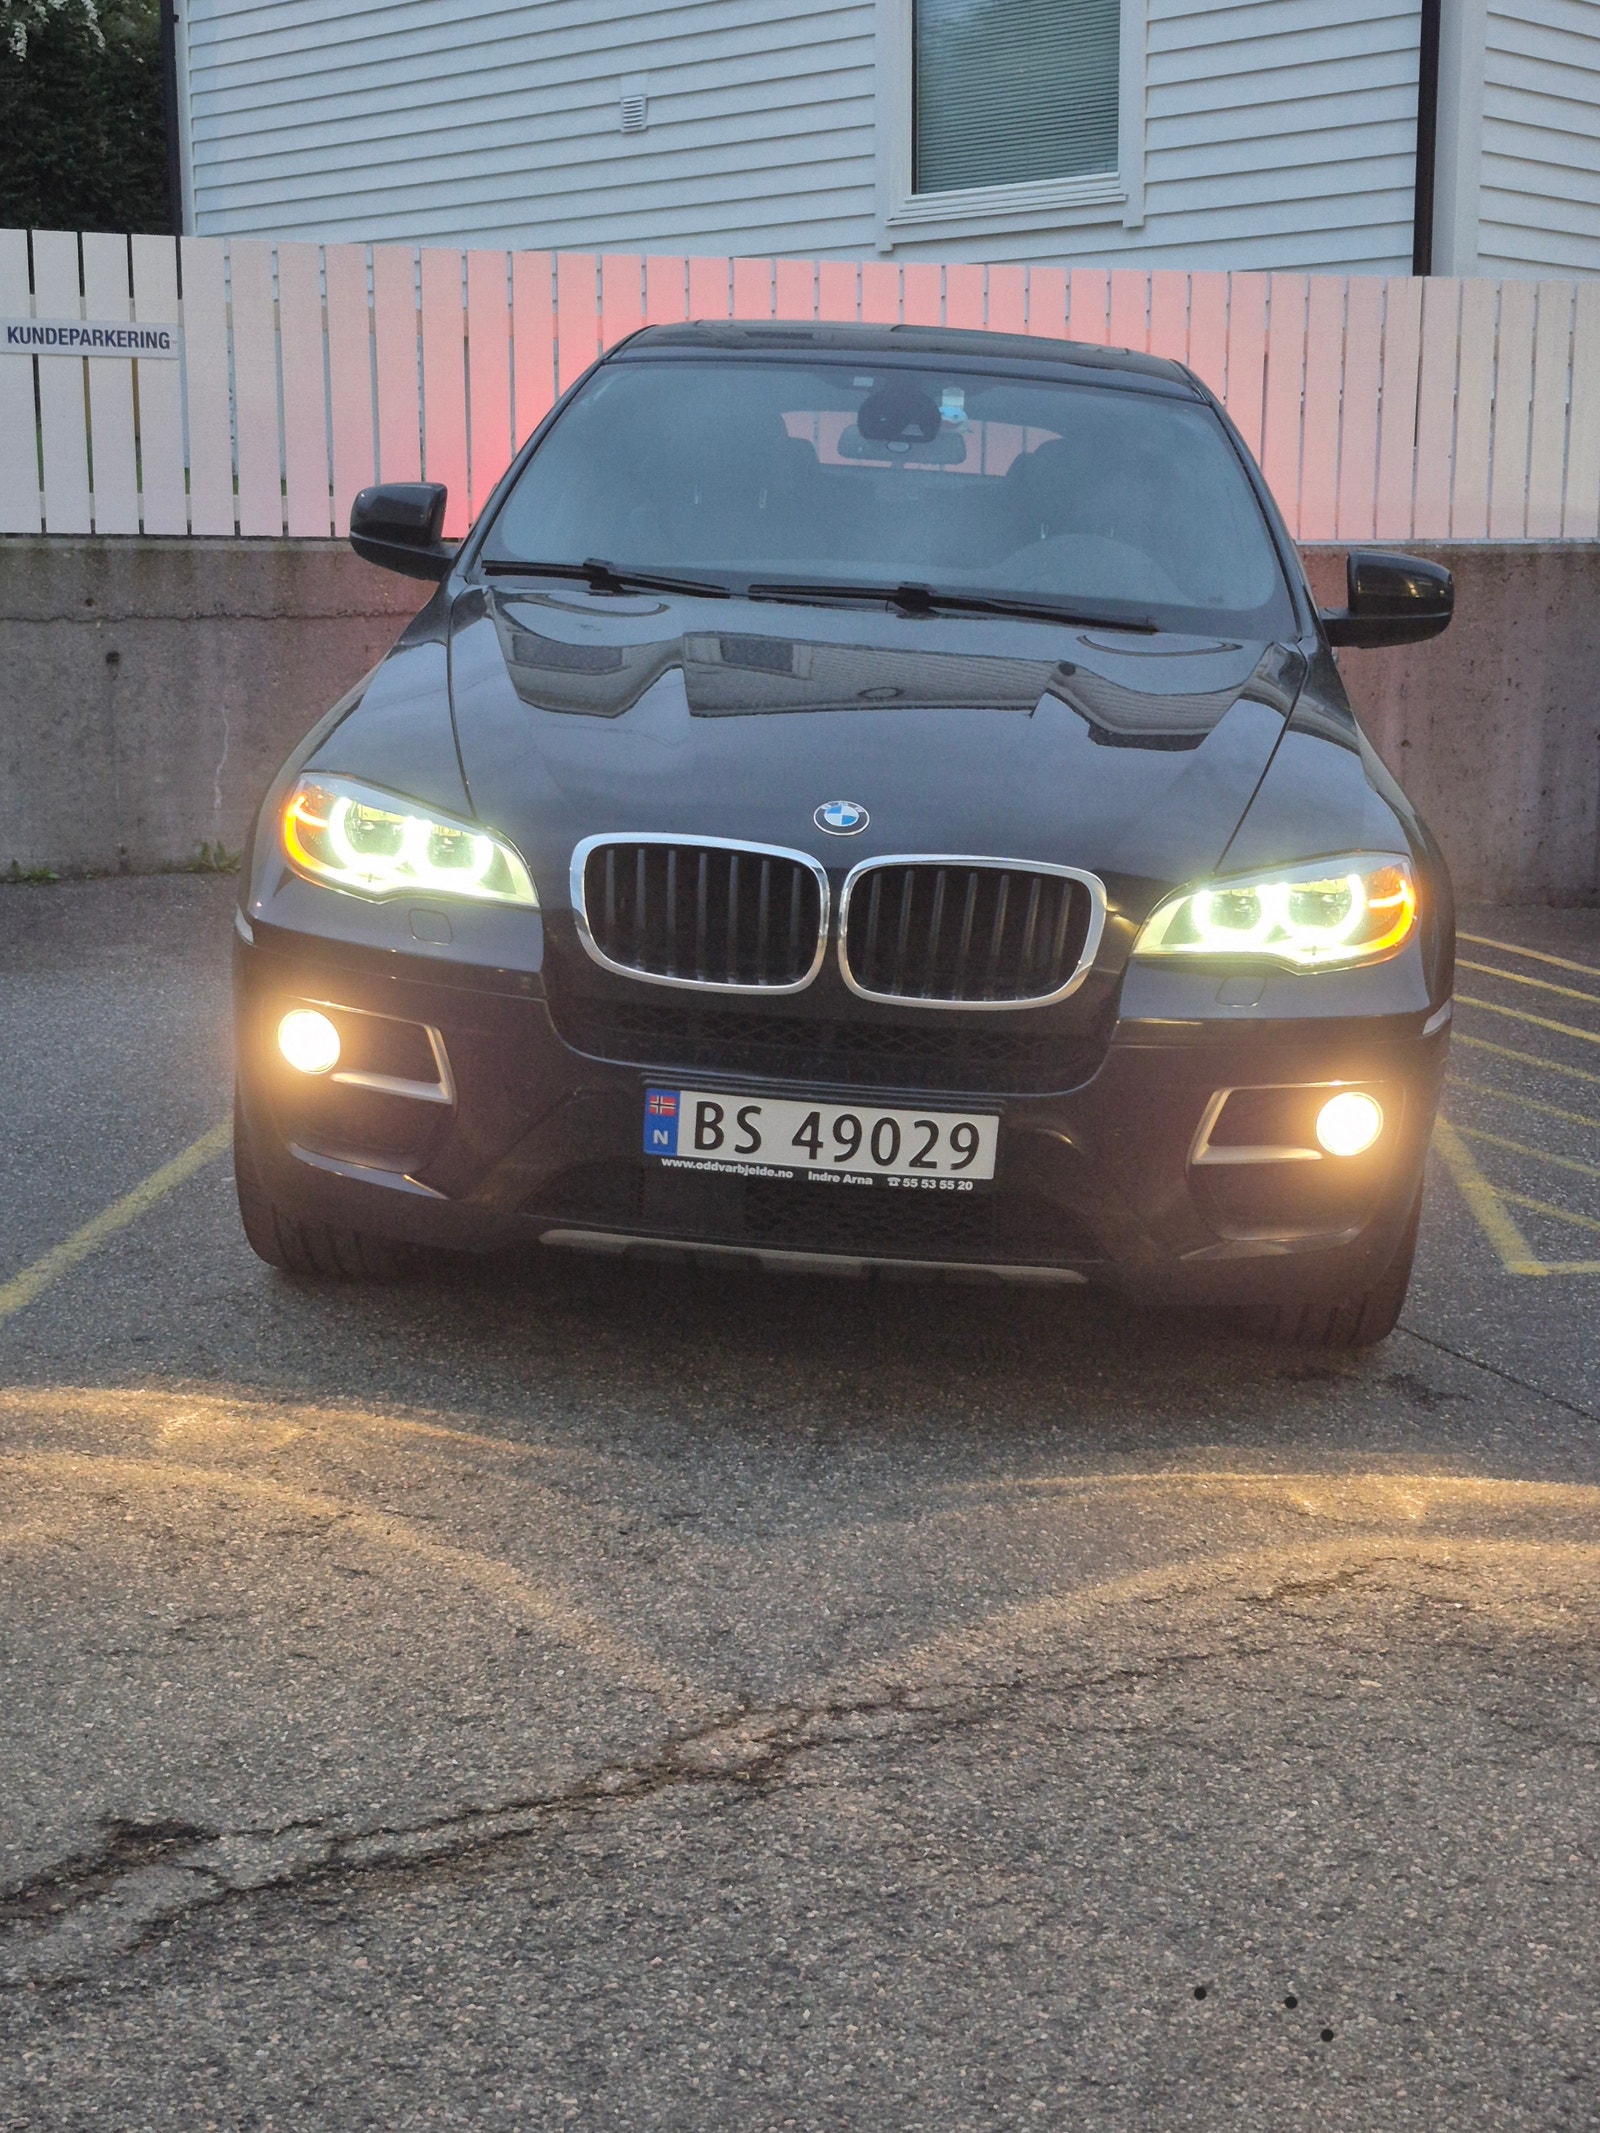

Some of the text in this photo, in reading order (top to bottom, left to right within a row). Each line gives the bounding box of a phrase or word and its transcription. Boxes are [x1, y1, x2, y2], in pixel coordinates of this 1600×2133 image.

[7, 326, 171, 350] KUNDEPARKERING
[653, 1129, 669, 1146] N
[694, 1101, 980, 1170] BS 49029
[808, 1171, 841, 1183] Indre
[843, 1174, 873, 1185] Arna
[902, 1178, 918, 1188] 55
[921, 1179, 937, 1189] 53
[939, 1180, 955, 1190] 55
[957, 1181, 974, 1191] 20
